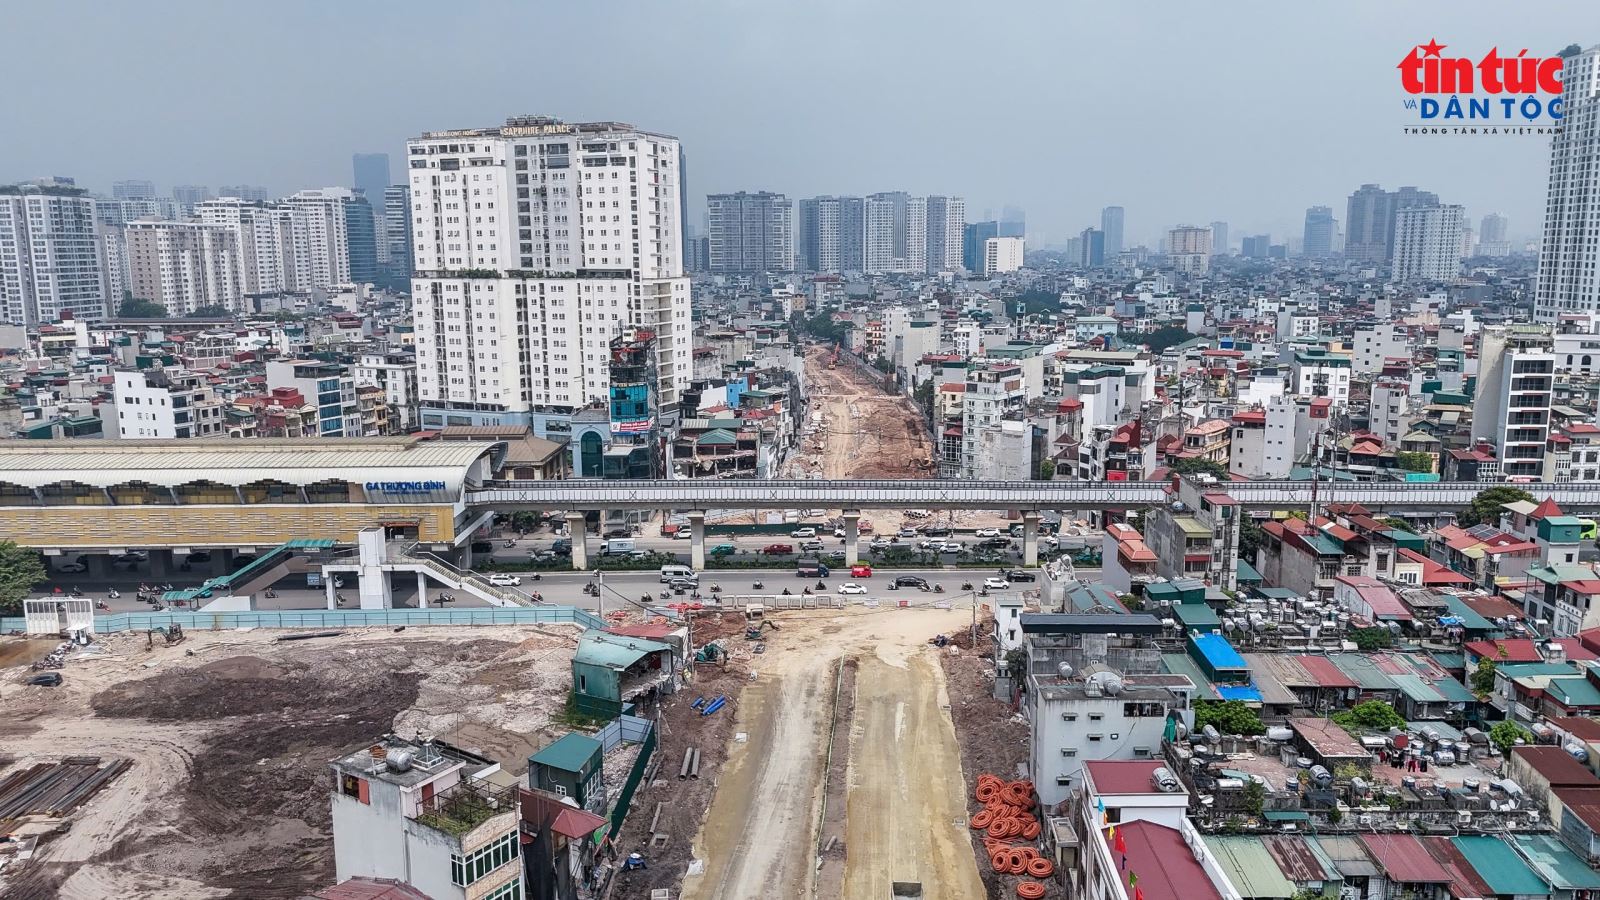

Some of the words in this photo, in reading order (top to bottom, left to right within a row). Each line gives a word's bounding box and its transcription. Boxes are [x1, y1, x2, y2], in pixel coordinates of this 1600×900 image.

[503, 126, 540, 136] SAPPHIRE
[543, 124, 571, 134] PALACE
[366, 481, 379, 491] GA
